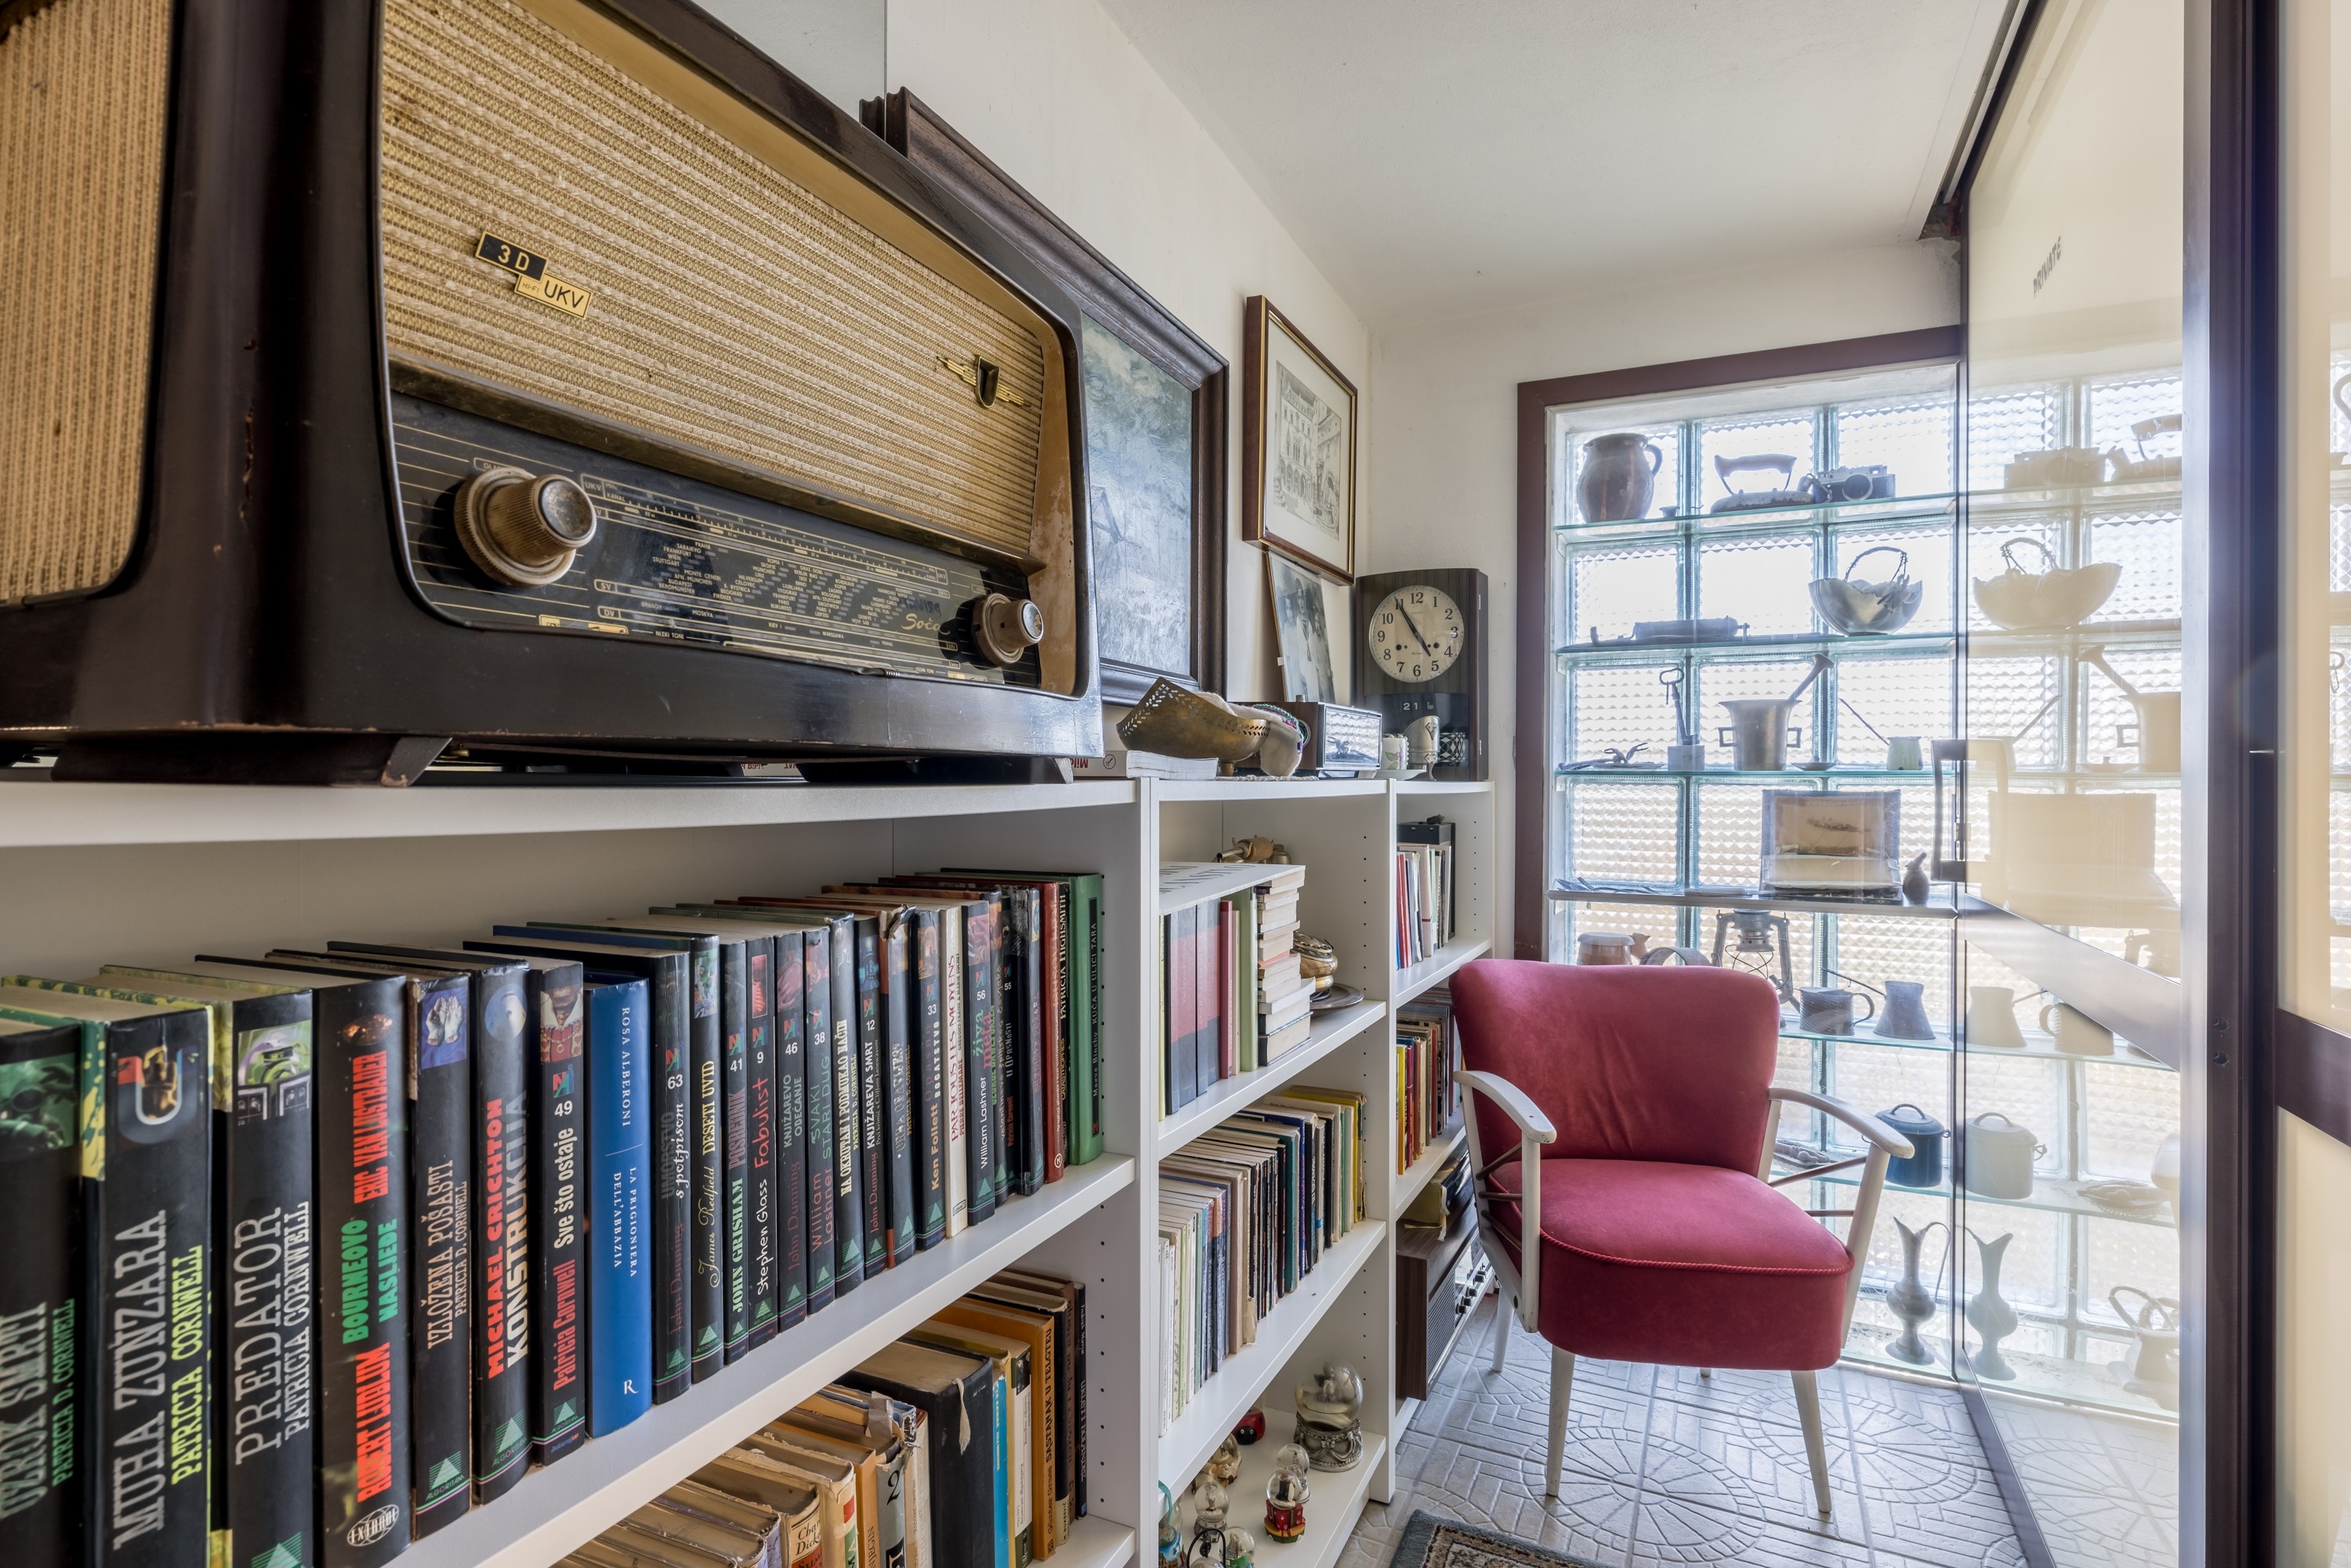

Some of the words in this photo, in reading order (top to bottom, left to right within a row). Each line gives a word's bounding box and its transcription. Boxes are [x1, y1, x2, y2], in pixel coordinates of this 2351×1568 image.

[522, 282, 539, 294] HI-FI
[2033, 235, 2061, 299] PRIVATE
[544, 280, 584, 308] UKV
[585, 482, 602, 491] UKV
[607, 491, 625, 502] KANAL
[652, 556, 680, 567] STUTTGART
[676, 543, 701, 554] SARAJEVO
[600, 582, 612, 591] SV
[1395, 598, 1404, 610] 11
[1411, 592, 1424, 604] 12
[1433, 596, 1438, 607] 1
[603, 609, 615, 617] DV
[692, 609, 714, 618] MOSKVA
[902, 612, 951, 636] Soča
[1382, 613, 1393, 625] 10
[1444, 608, 1453, 620] 2
[1451, 627, 1458, 639] 3
[655, 630, 670, 639] NIZKI
[1377, 630, 1386, 642] 9
[1383, 648, 1391, 661] 8
[1444, 646, 1453, 657] 4
[1396, 661, 1405, 672] 7
[1413, 664, 1421, 677] 6
[1431, 660, 1439, 672] 5
[1058, 894, 1067, 963] HIGHSMITH
[976, 990, 986, 1001] 56
[1004, 982, 1012, 990] 55
[1058, 966, 1067, 1019] PATRICIA
[621, 1006, 631, 1046] ROSA
[867, 1019, 875, 1031] 12
[928, 1004, 937, 1016] 33
[785, 1041, 798, 1055] 46
[814, 1032, 825, 1045] 38
[835, 1019, 848, 1054] NAČIN
[973, 1009, 984, 1056] živa
[982, 1012, 992, 1068] meta
[730, 1058, 743, 1072] 41
[756, 1051, 764, 1063] 9
[820, 1056, 831, 1097] DUG
[864, 1041, 874, 1075] SMRT
[1005, 1069, 1014, 1077] U
[353, 1051, 388, 1135] LUSTBADER
[621, 1051, 631, 1128] ALBERONI
[667, 1074, 683, 1090] 63
[701, 1060, 715, 1098] UVID
[837, 1056, 850, 1117] PODMUKAO
[979, 1077, 987, 1121] Lashner
[554, 1100, 573, 1117] 49
[752, 1077, 770, 1168] Fabulist
[780, 1074, 793, 1148] KNJIŽAREVO
[792, 1076, 802, 1137] OBEĆANJE
[864, 1077, 875, 1150] KNJIŽAREVA
[951, 1108, 959, 1143] PAR
[353, 1129, 388, 1168] VAN
[672, 1103, 689, 1188] potpisom
[702, 1102, 716, 1155] DESETI
[727, 1091, 745, 1171] POSREDNIK
[821, 1099, 832, 1160] STARI
[929, 1103, 939, 1154] Follett
[980, 1122, 989, 1169] William
[487, 1098, 504, 1241] CRICHTON
[555, 1127, 578, 1182] ostaje
[661, 1111, 676, 1200] UMORSTVO
[839, 1125, 852, 1177] OKRUTAN
[353, 1166, 388, 1204] ERIC
[629, 1167, 638, 1186] LA
[787, 1161, 801, 1222] Dunning
[840, 1176, 853, 1197] NA
[868, 1152, 879, 1196] Dunning
[931, 1155, 940, 1191] Ken
[421, 1160, 454, 1247] POŠASTI
[455, 1182, 468, 1243] CORNWELL
[552, 1184, 574, 1215] što
[676, 1190, 684, 1199] s
[697, 1165, 718, 1226] Redfield
[755, 1179, 768, 1222] Glass
[810, 1172, 822, 1252] William
[822, 1168, 835, 1244] Lashner
[869, 1197, 880, 1233] John
[505, 1089, 529, 1368] KONSTRUKCIJA
[555, 1216, 574, 1249] Sve
[613, 1171, 624, 1268] DELL'ABBAZIA
[629, 1188, 638, 1278] PRIGIONIERA
[730, 1177, 744, 1262] GRISHAM
[284, 1201, 310, 1327] CORNWELL
[455, 1243, 468, 1255] D.
[670, 1223, 684, 1293] Dunning
[699, 1232, 721, 1287] James
[756, 1226, 773, 1295] Stephen
[788, 1226, 803, 1269] John
[172, 1244, 203, 1360] CORNWELL
[342, 1219, 369, 1344] BOURNEOVO
[421, 1248, 454, 1349] IZLOŽENA
[455, 1256, 468, 1316] PATRICIA
[552, 1258, 577, 1330] Cornwell
[731, 1266, 744, 1313] JOHN
[114, 1210, 166, 1410] ZUNZARA
[487, 1245, 505, 1379] MICHAEL
[669, 1296, 684, 1333] John
[0, 1302, 46, 1407] SMRTI
[53, 1298, 74, 1382] CORNWELL
[234, 1207, 282, 1465] PREDATOR
[553, 1330, 577, 1391] Patricia
[53, 1383, 74, 1405] D.
[284, 1326, 310, 1440] PATRICIA
[355, 1342, 392, 1429] LUDLUM
[623, 1379, 639, 1395] R
[1045, 1386, 1052, 1395] U
[53, 1403, 74, 1486] PATRICIA
[172, 1366, 203, 1485] PATRICIA
[551, 1414, 579, 1434] ALGORITAM
[1045, 1397, 1053, 1463] SASTANAK
[0, 1403, 47, 1518] UZROK
[357, 1421, 392, 1502] ROBERT
[492, 1437, 528, 1467] ALGORITAM
[114, 1410, 166, 1550] MUHA
[426, 1475, 465, 1501] ALGORITAM
[886, 1469, 900, 1505] 2
[1045, 1465, 1054, 1496] Grass
[1045, 1497, 1054, 1534] Günter
